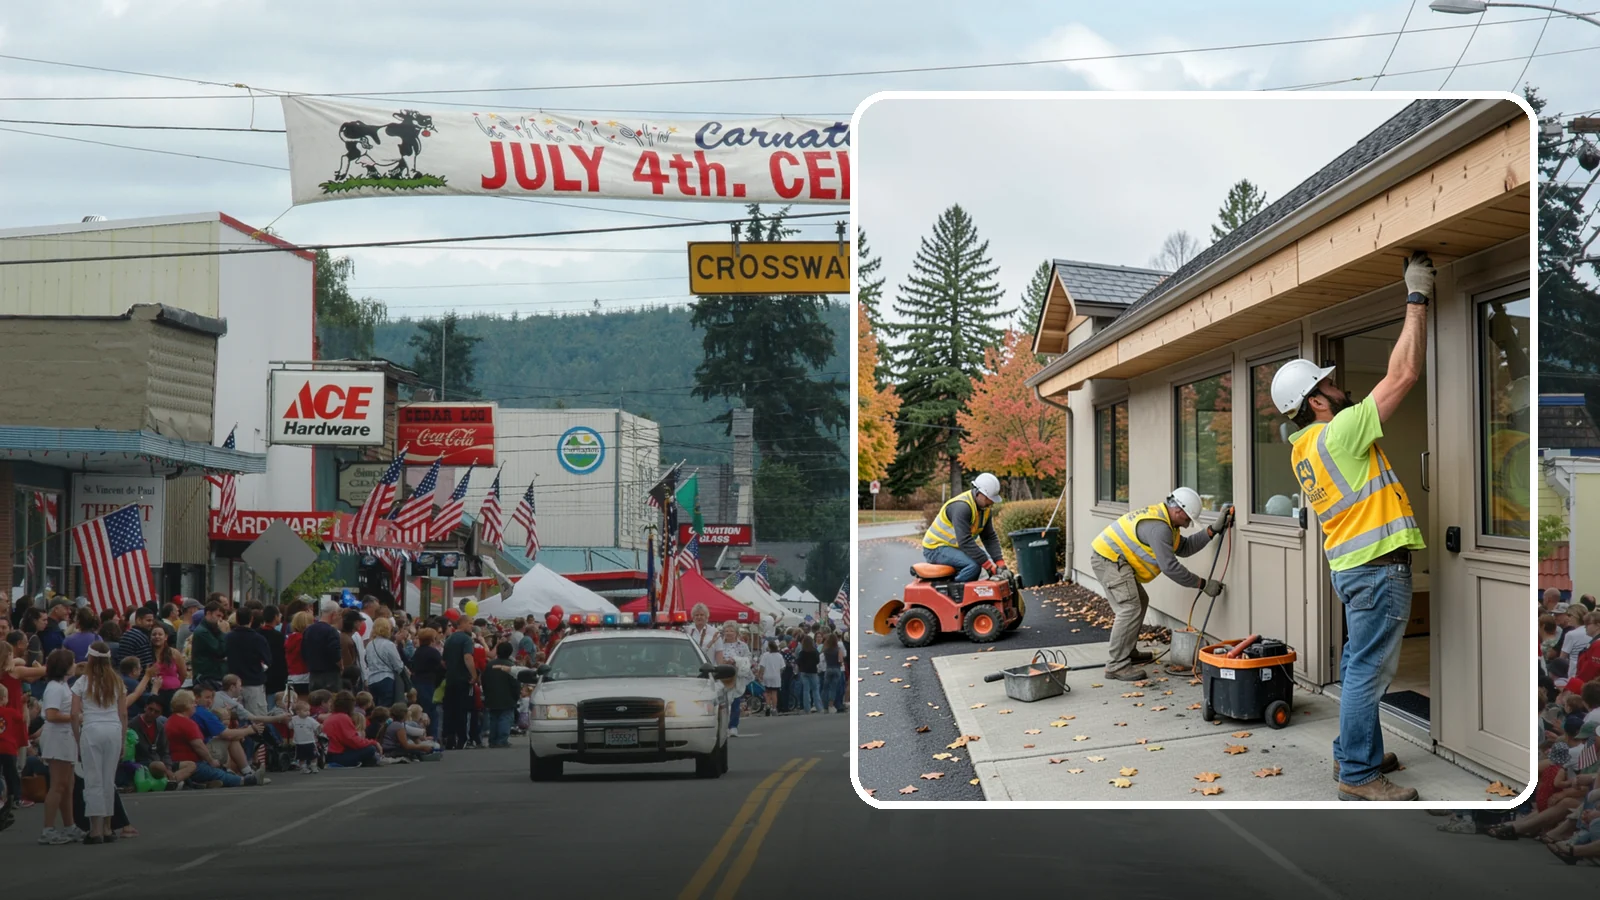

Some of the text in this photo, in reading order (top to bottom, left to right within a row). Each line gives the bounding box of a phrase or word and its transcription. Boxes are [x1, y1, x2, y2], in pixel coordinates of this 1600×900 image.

[695, 121, 850, 150] Carnat
[481, 141, 605, 192] JULY
[632, 150, 746, 198] 4th.
[697, 254, 850, 280] CROSSWA
[282, 380, 374, 420] ACE
[406, 410, 452, 422] CEDAR
[284, 421, 370, 436] Hardware
[416, 428, 477, 447] Coca-Cola
[83, 485, 155, 495] St. Vincent de Paul
[688, 526, 741, 535] CRNATION
[699, 535, 730, 543] GLASS
